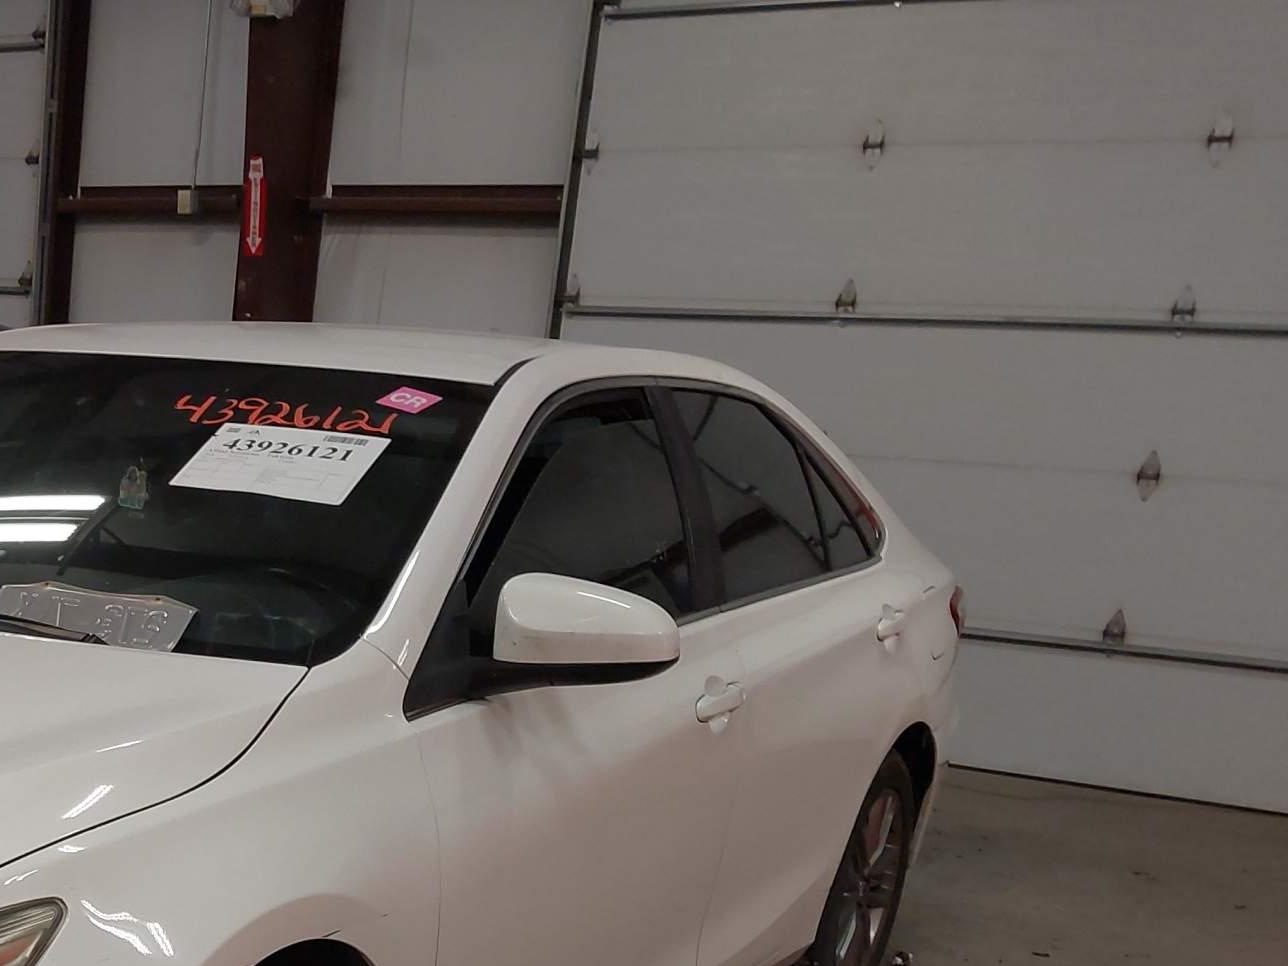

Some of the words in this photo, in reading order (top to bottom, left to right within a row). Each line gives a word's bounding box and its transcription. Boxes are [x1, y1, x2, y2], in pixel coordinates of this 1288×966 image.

[389, 392, 427, 407] CR
[174, 394, 399, 435] 43926121
[222, 437, 354, 463] 43926121
